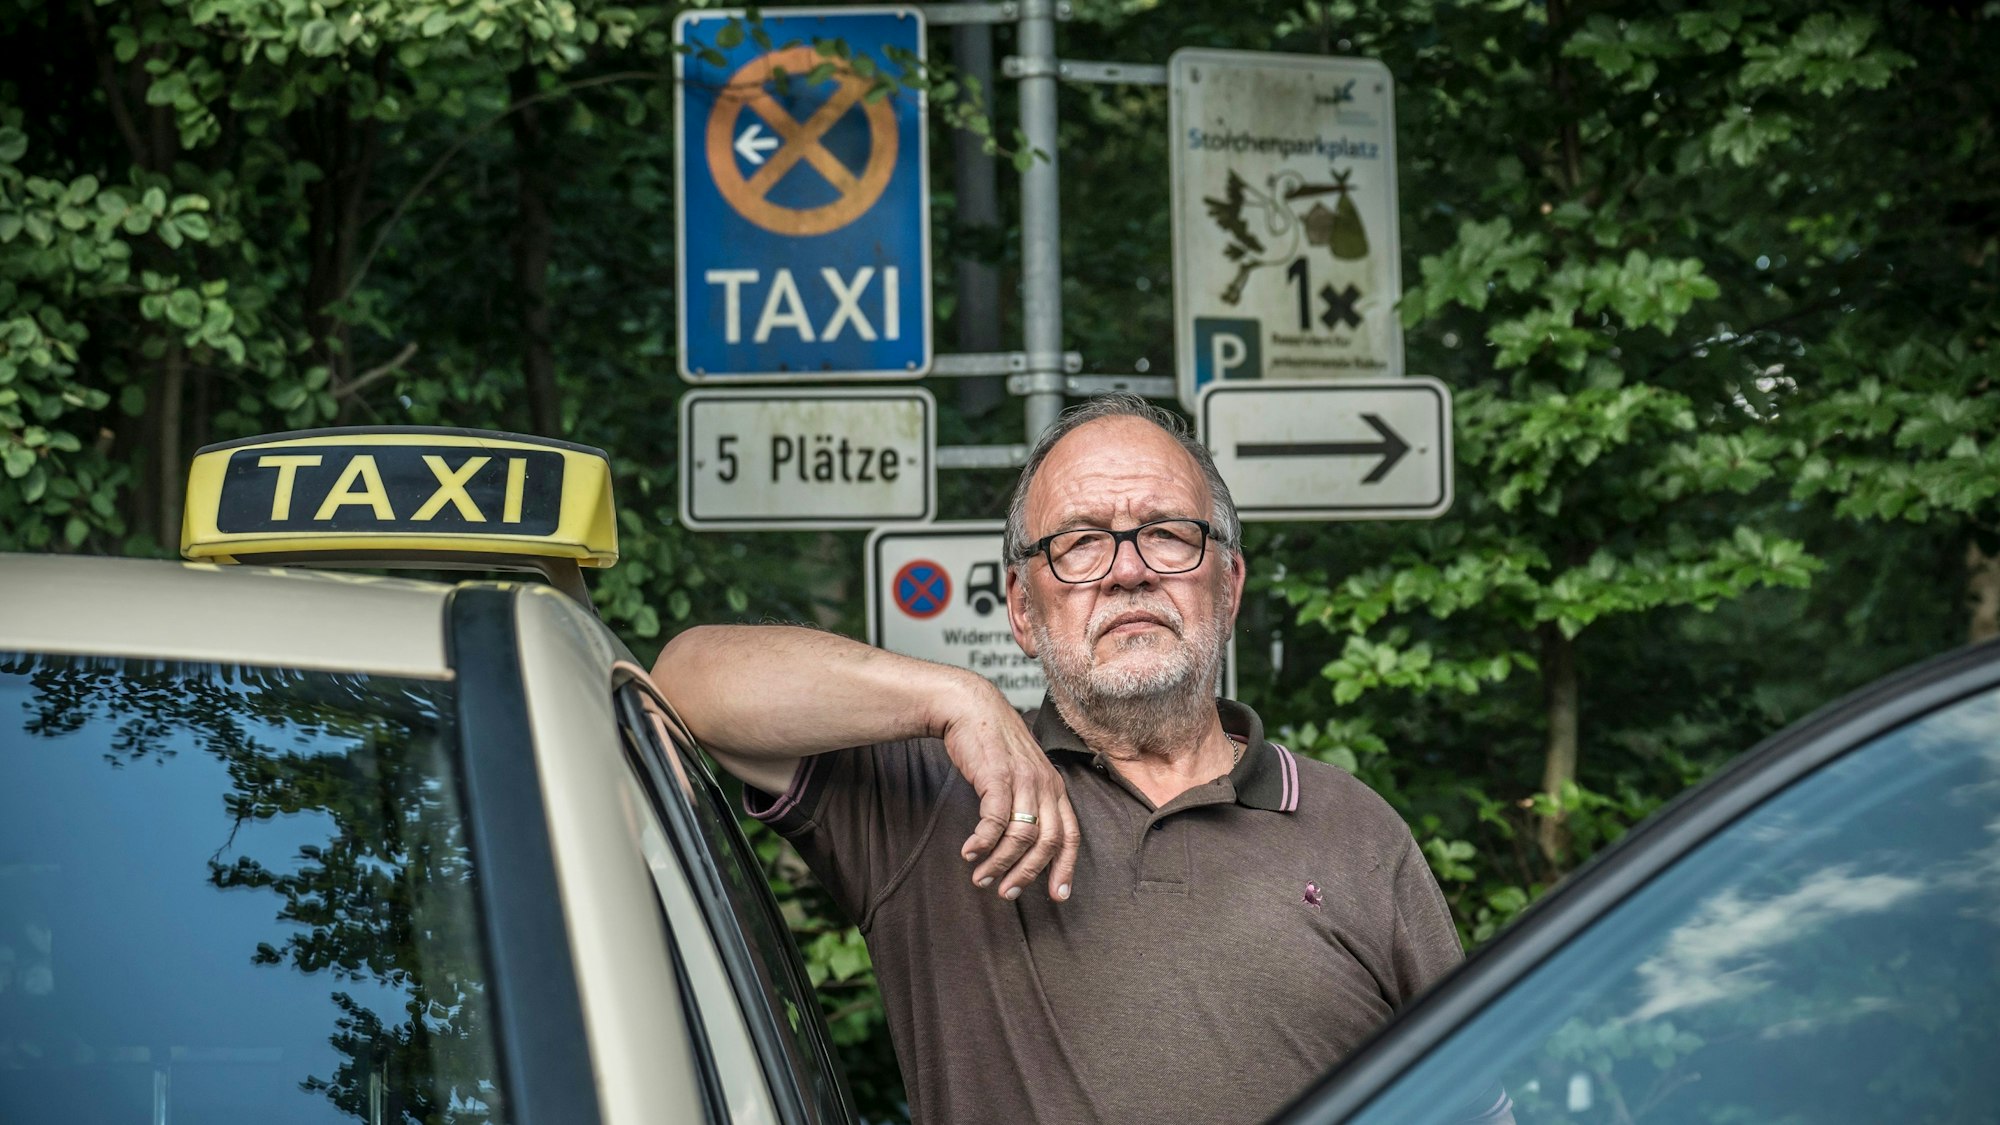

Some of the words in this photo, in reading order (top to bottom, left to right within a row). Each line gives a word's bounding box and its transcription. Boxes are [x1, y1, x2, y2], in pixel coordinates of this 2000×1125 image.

[1189, 129, 1379, 160] Storchenparkplatz
[705, 266, 901, 344] TAXI
[1212, 334, 1247, 378] P
[717, 434, 738, 484] 5
[770, 433, 900, 484] Plätze
[257, 454, 528, 524] TAXI
[943, 629, 1014, 645] Widerre
